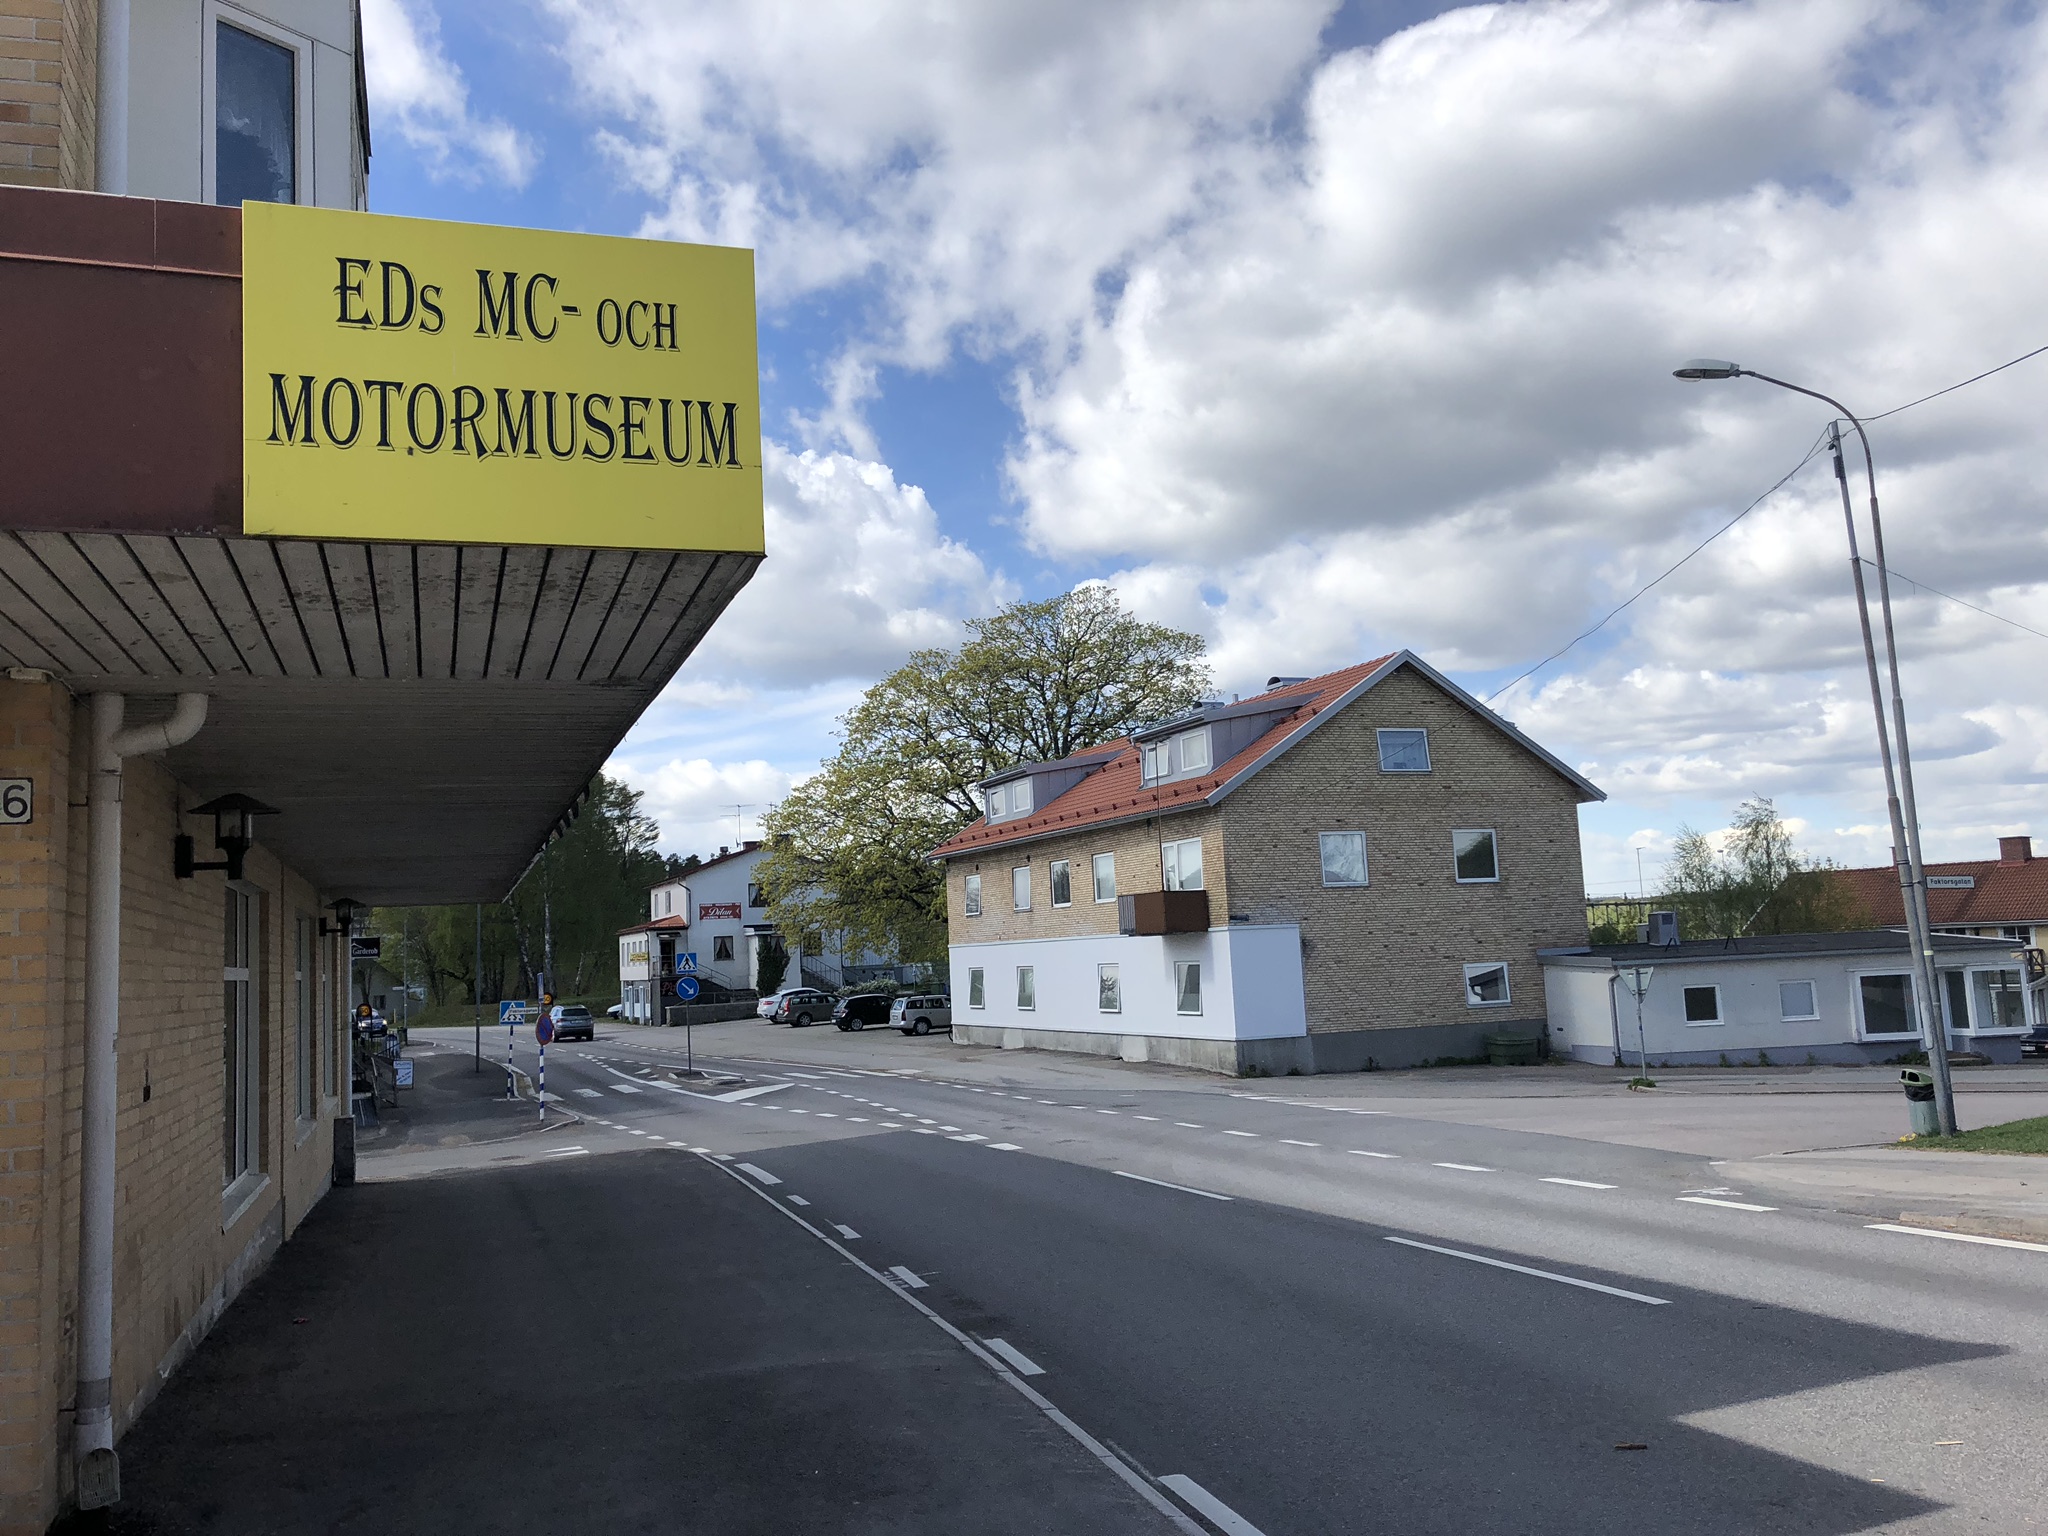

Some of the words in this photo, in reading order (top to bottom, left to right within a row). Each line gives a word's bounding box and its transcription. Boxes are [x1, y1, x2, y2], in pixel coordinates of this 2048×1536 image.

[333, 257, 445, 335] EDs
[473, 269, 582, 342] MC-
[596, 298, 681, 352] OCH
[265, 372, 742, 469] MOTORMUSEUM
[3, 784, 28, 818] 6
[1930, 878, 1972, 886] Faktorsgatan
[707, 906, 733, 916] Dilan
[352, 946, 379, 955] Garderob
